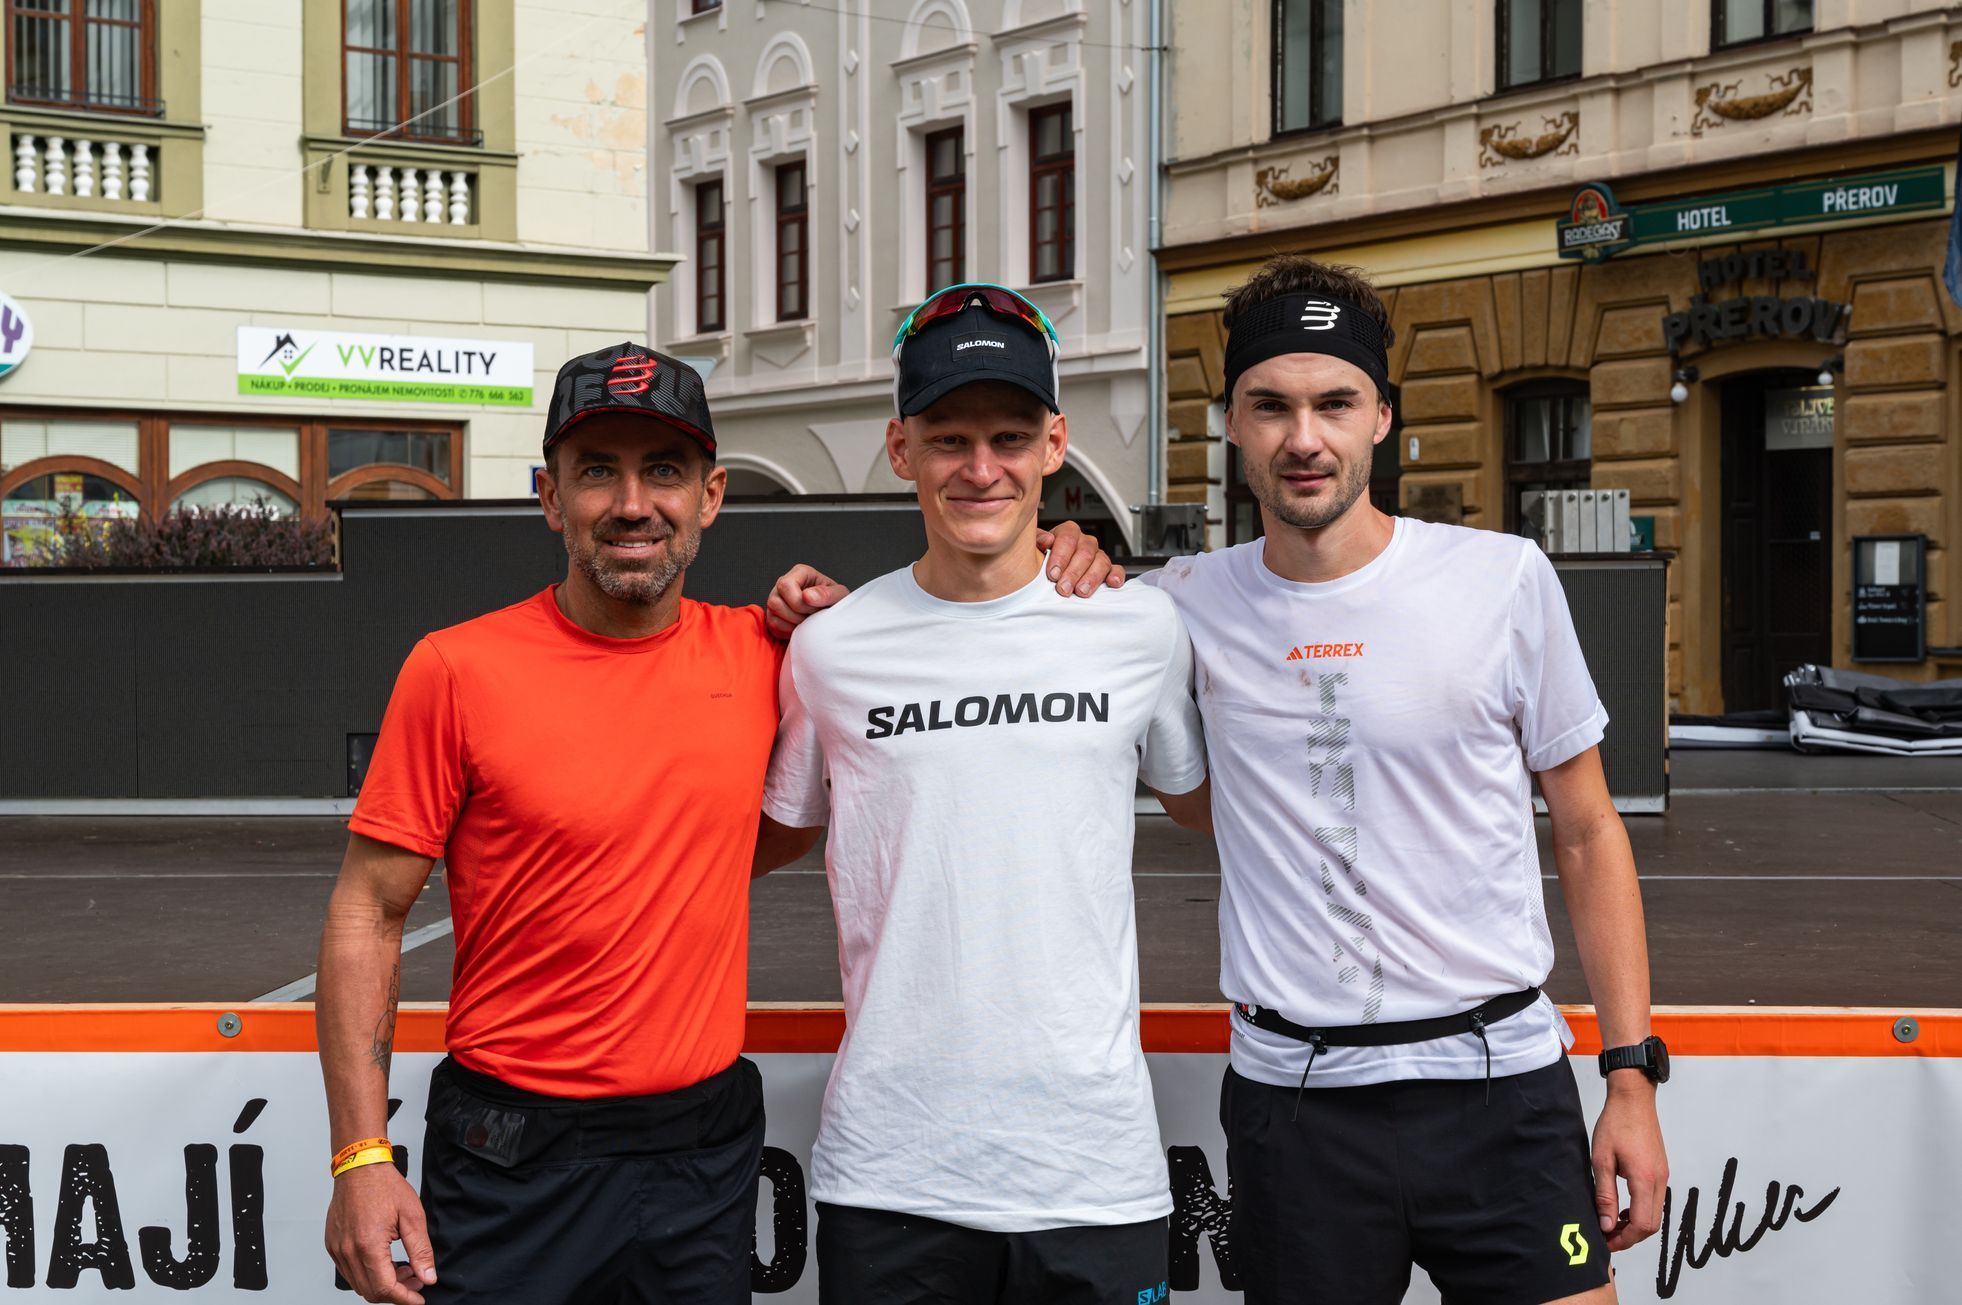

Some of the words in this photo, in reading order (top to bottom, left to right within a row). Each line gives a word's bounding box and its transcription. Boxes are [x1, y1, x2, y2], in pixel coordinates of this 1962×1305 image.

[1677, 206, 1732, 231] HOTEL
[1822, 184, 1898, 213] PŘEROV
[1564, 220, 1624, 246] RADEGAST
[1698, 249, 1815, 289] HOTEL
[1662, 294, 1848, 349] PŘEROV
[956, 339, 1005, 351] SALOMON
[251, 379, 286, 390] NÁKUP
[294, 381, 330, 393] PRODEJ
[339, 382, 390, 395] PRONÁJEM
[392, 386, 455, 398] NEMOVITOSTÍ
[1303, 643, 1364, 659] TERREX
[866, 692, 1109, 739] SALOMON
